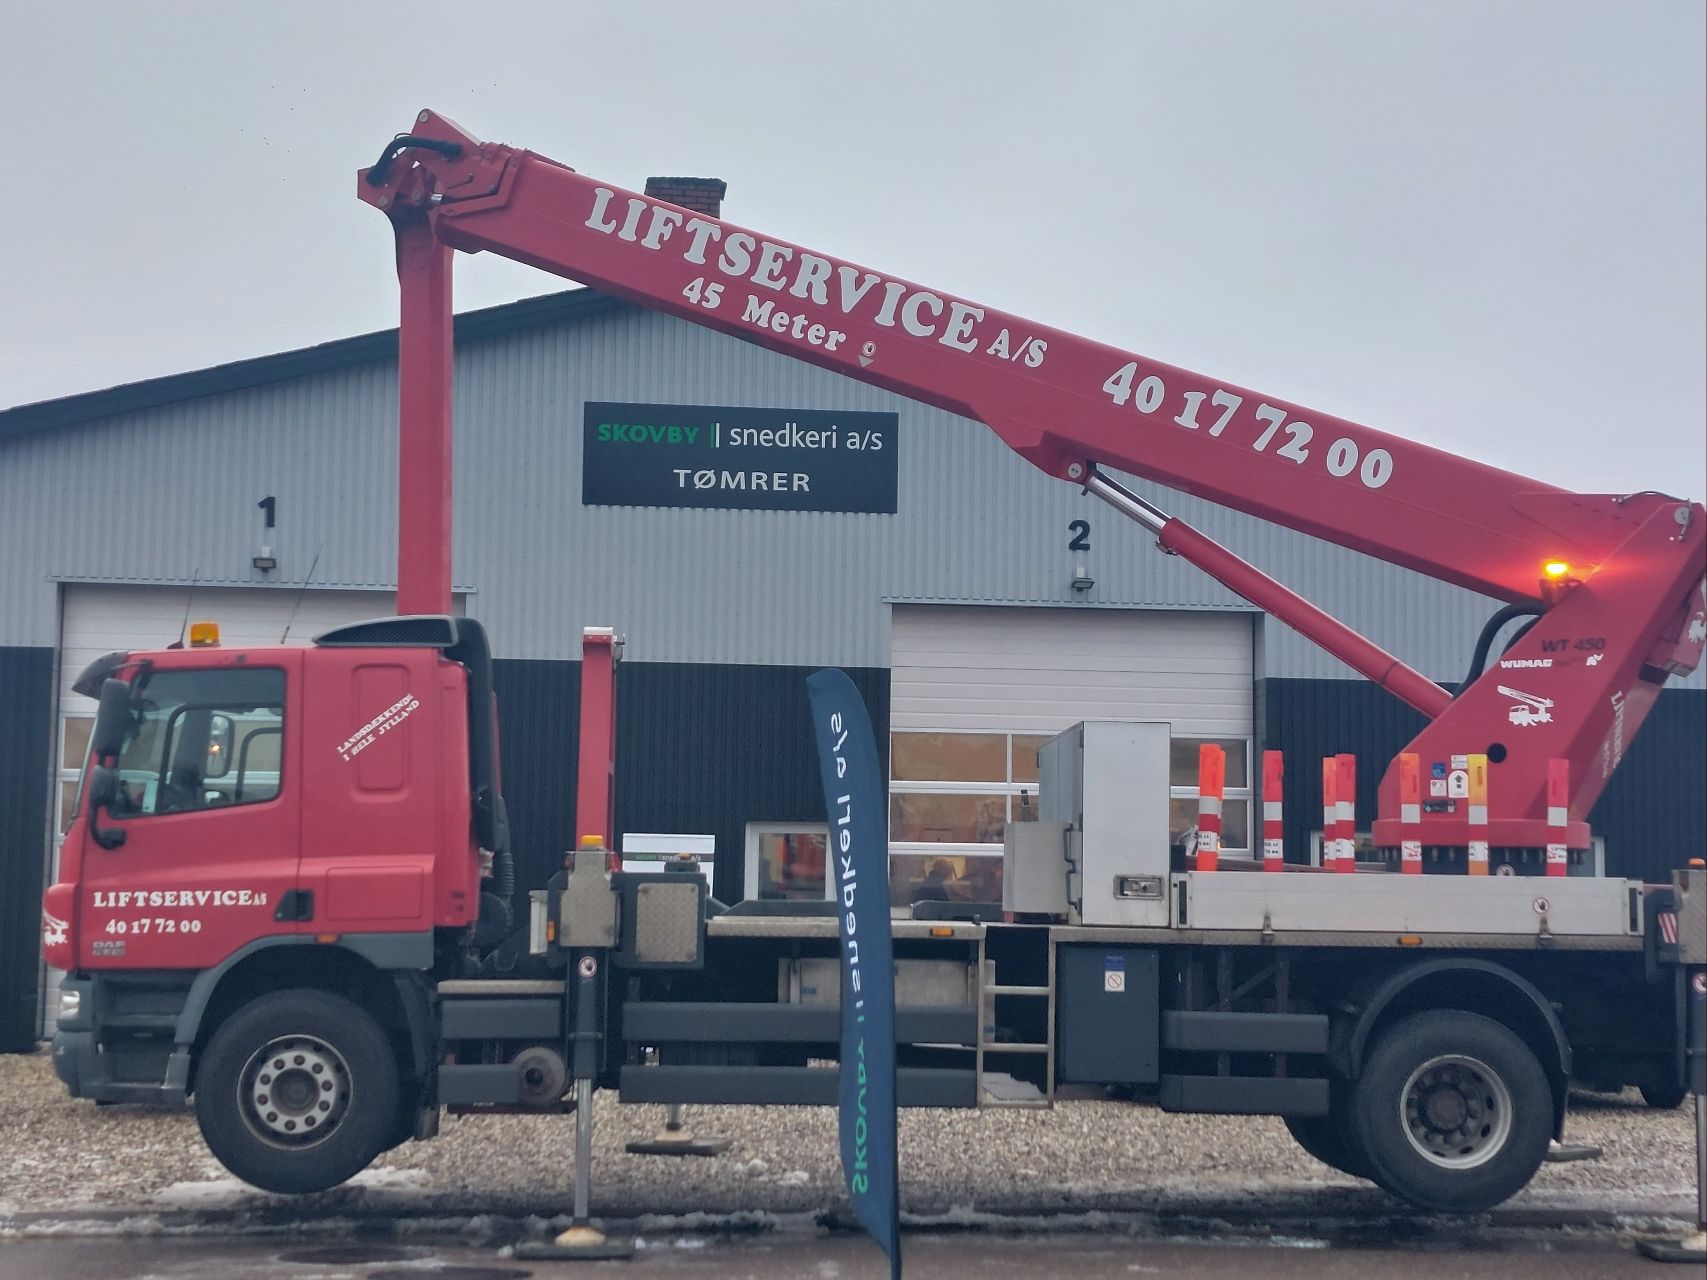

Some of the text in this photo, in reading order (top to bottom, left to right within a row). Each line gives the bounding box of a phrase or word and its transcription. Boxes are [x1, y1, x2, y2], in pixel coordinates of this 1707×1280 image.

[585, 187, 1048, 368] LIFTSERVICE A/S
[682, 277, 847, 352] 45 Meter
[598, 422, 883, 452] SKOVBY snedkeri a/s
[1103, 362, 1393, 489] 40 17 72 00
[673, 469, 811, 492] TØMRER
[257, 496, 276, 528] 1
[1068, 520, 1091, 551] 2
[1542, 638, 1606, 652] WT 450
[1500, 659, 1553, 668] WUMAG
[379, 700, 420, 735] JYLLAND
[93, 890, 252, 907] LIFTSERVICE
[106, 919, 201, 934] 40 17 72 00
